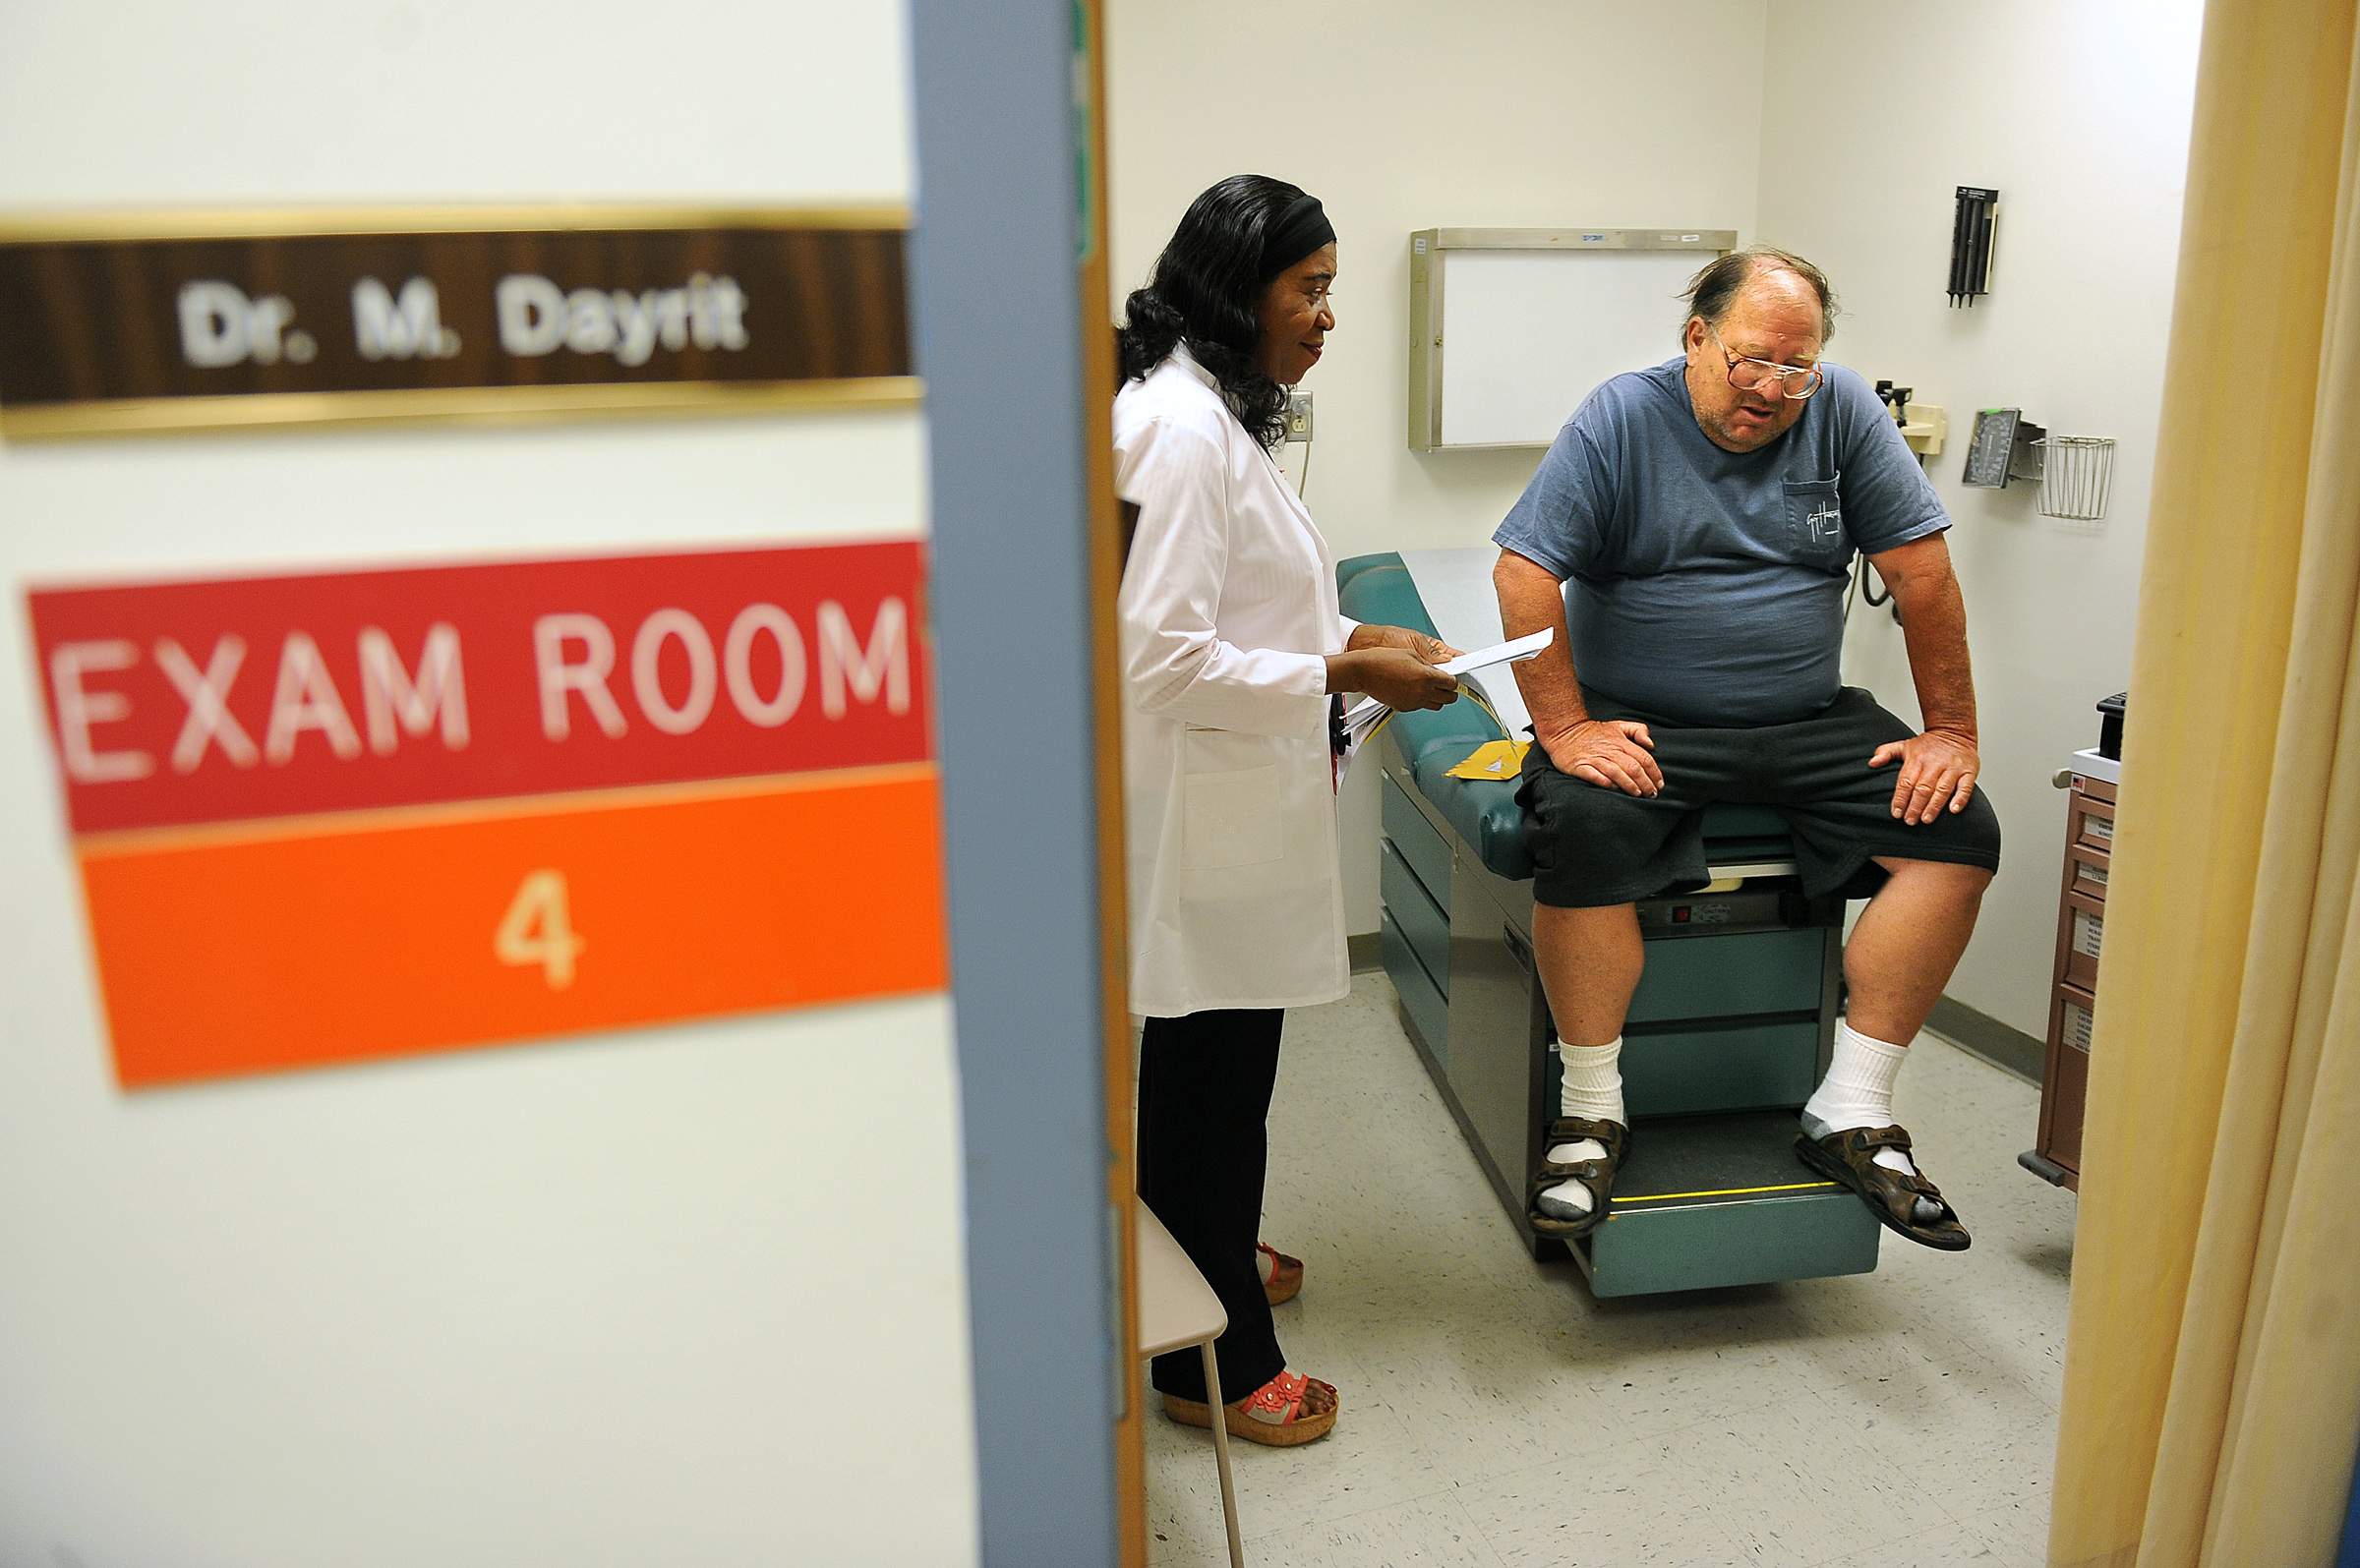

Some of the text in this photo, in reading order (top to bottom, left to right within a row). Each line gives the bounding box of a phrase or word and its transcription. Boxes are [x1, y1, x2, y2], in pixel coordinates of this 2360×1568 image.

[178, 272, 748, 368] Dr. M. Dayrit
[50, 596, 911, 784] EXAM ROOM
[495, 868, 586, 990] 4
